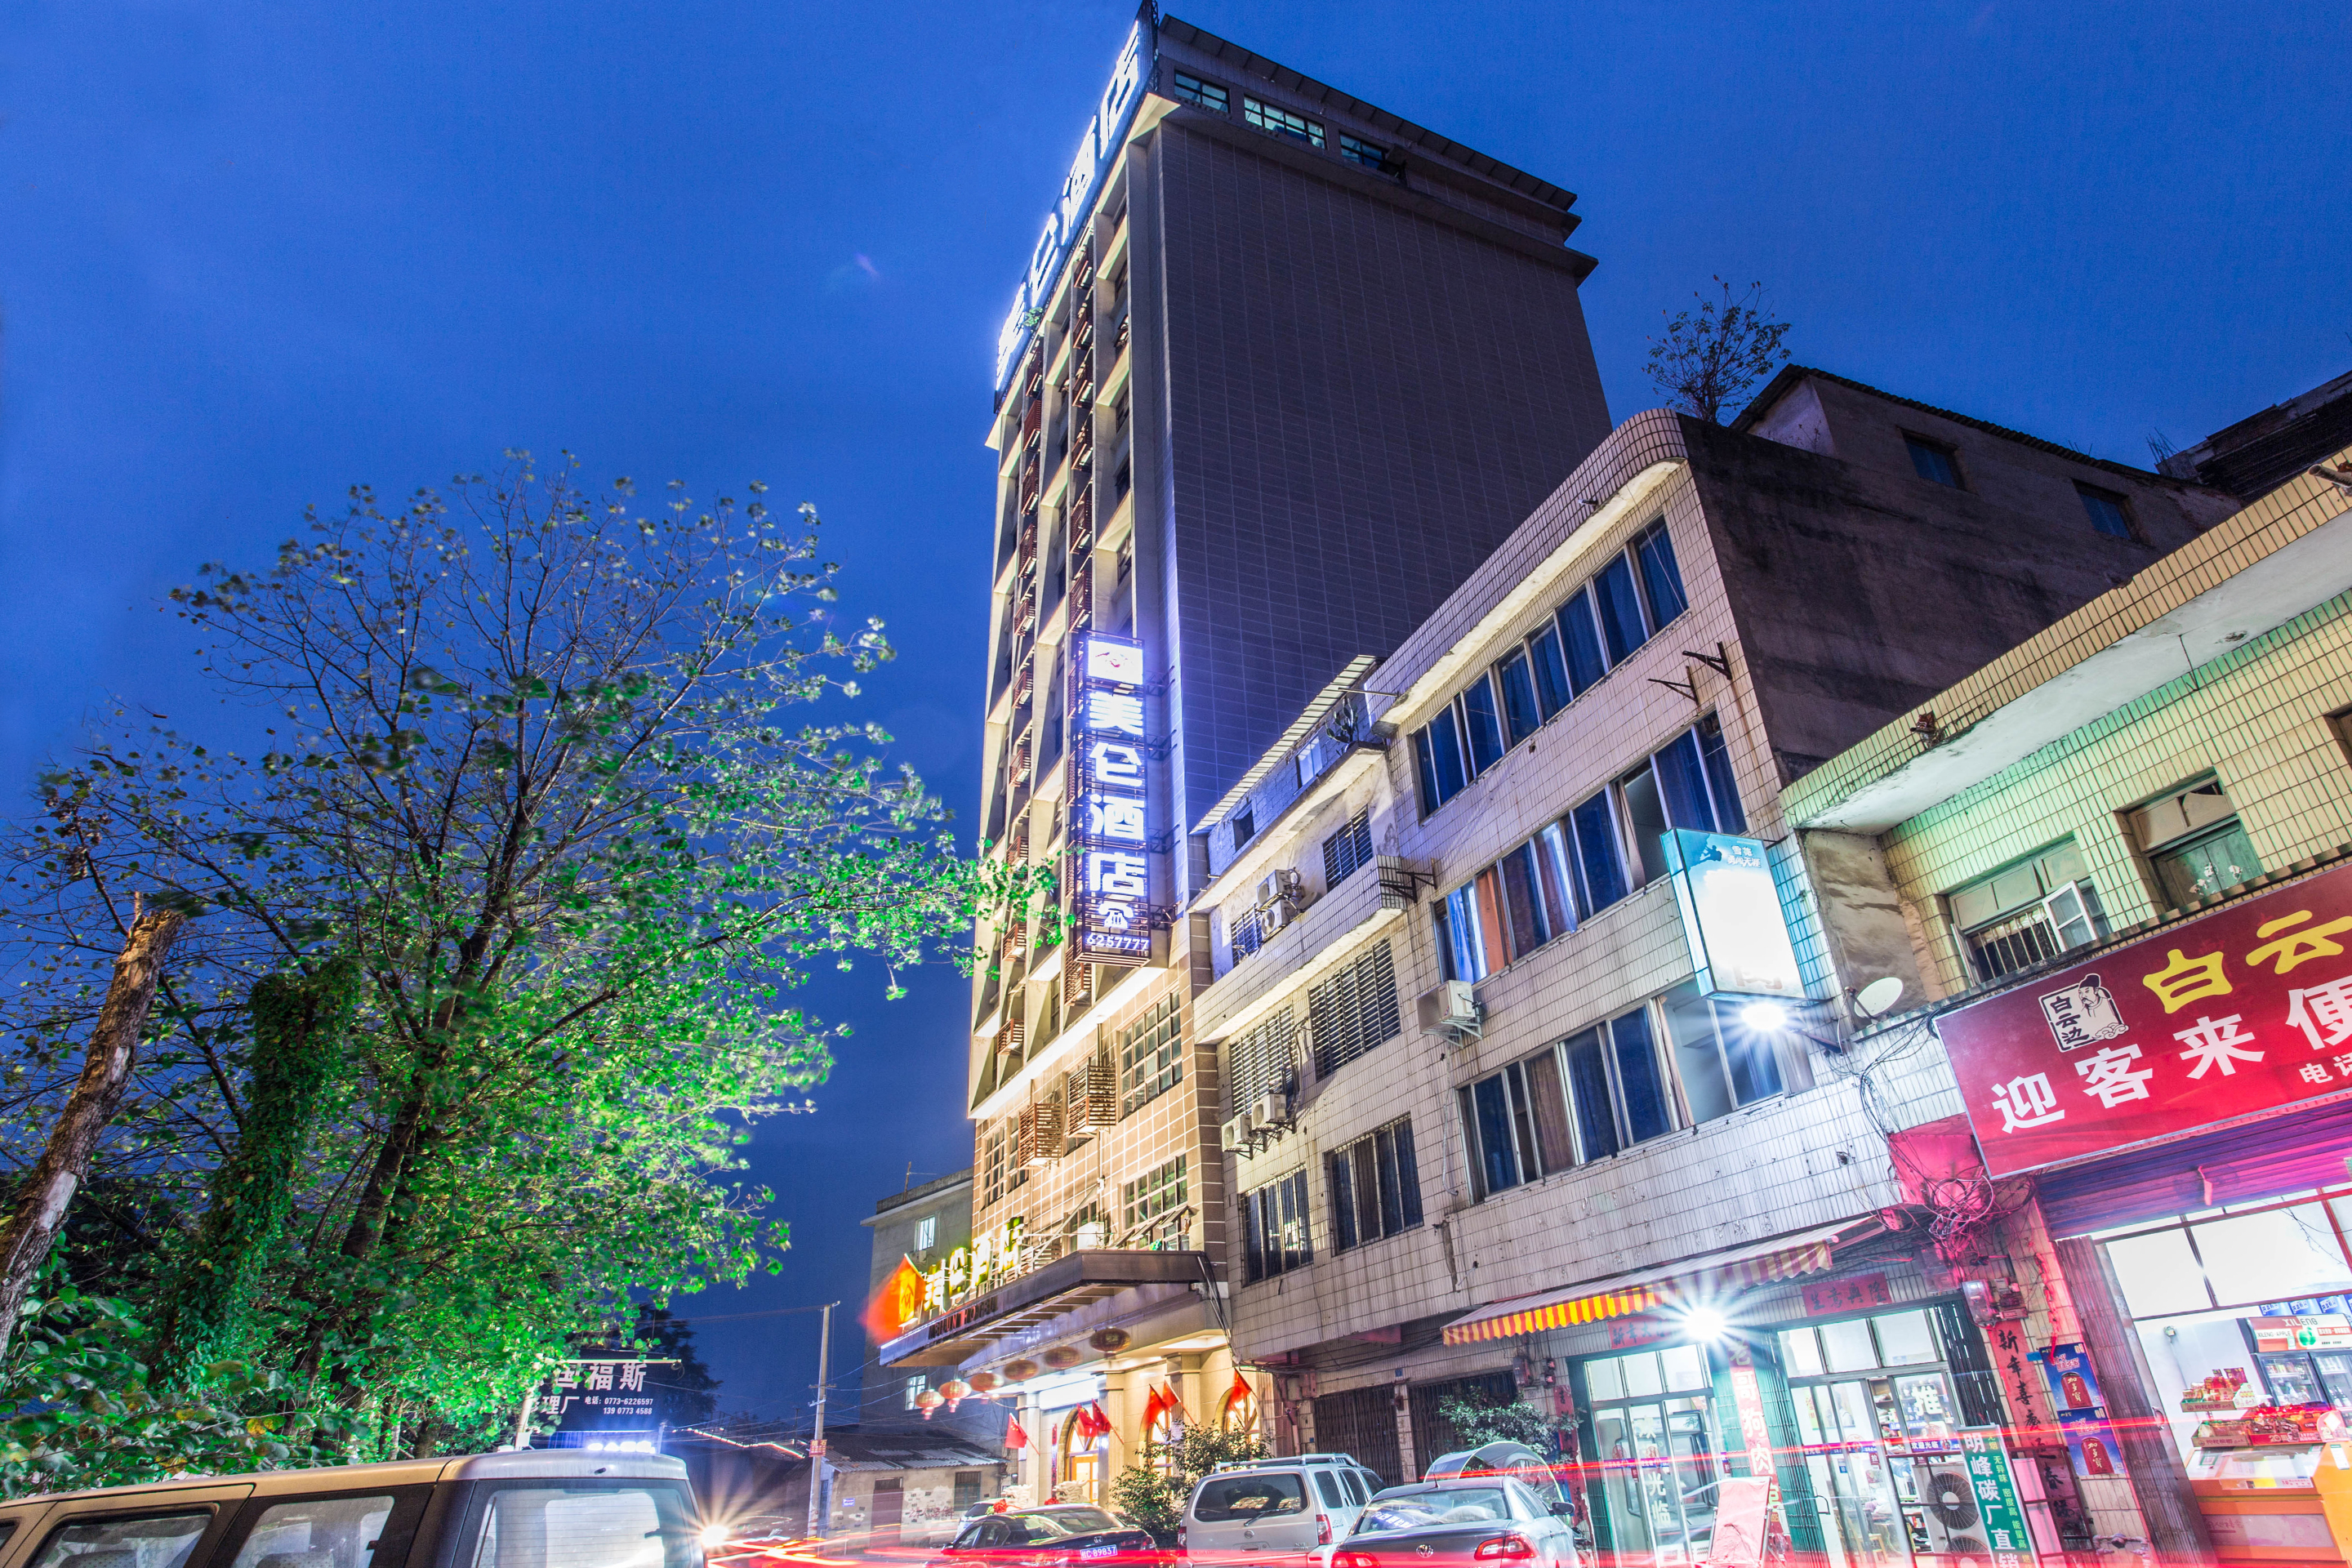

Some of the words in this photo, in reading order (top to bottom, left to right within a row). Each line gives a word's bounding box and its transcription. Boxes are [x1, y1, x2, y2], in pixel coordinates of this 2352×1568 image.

[1089, 691, 1145, 897] 美仑酒店
[1086, 934, 1149, 951] 6257777
[2143, 910, 2352, 1013] 白云
[2050, 996, 2090, 1043] 白云边
[1991, 975, 2352, 1135] 迎客来便
[2282, 1317, 2318, 1327] XILENG
[532, 1396, 580, 1414] 理厂
[604, 1397, 653, 1405] 0773-6226597
[1911, 1385, 1943, 1416] 推
[1911, 1441, 1939, 1450] 欢迎光临
[1638, 1415, 1672, 1526] 欢光临
[1993, 1455, 2007, 1483] 无异味
[1962, 1432, 2020, 1568] 明峰碳厂直销
[2002, 1488, 2018, 1517] 密度高
[2012, 1521, 2027, 1548] 能量高
